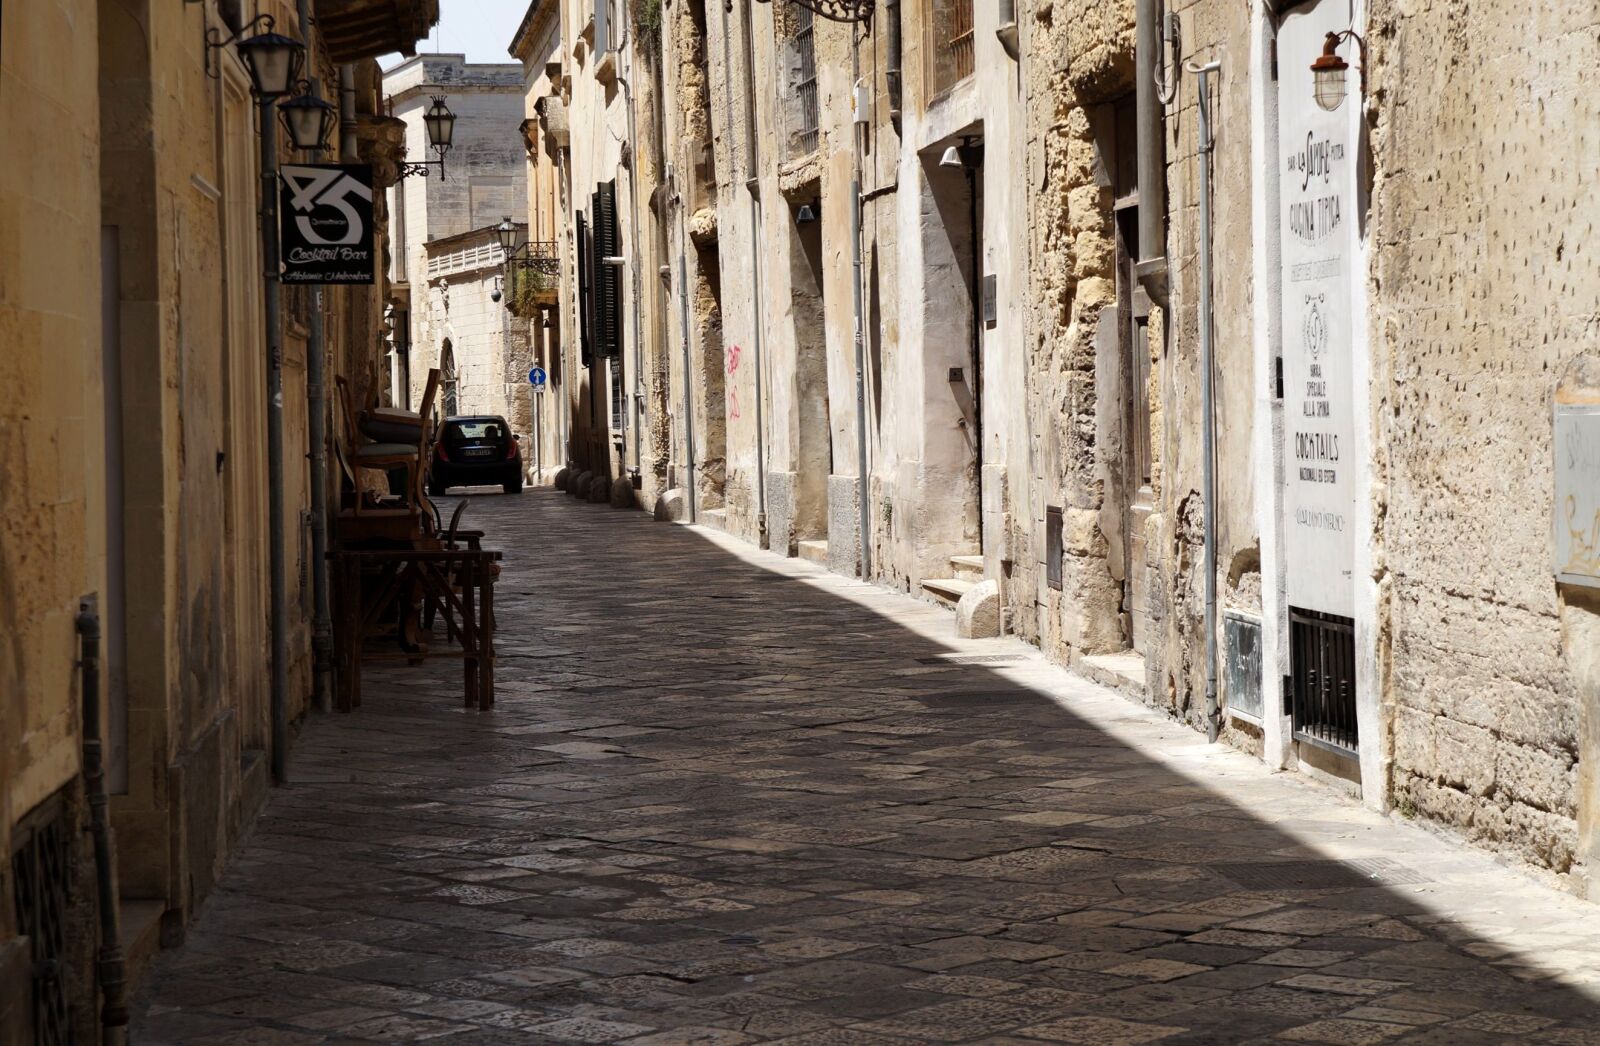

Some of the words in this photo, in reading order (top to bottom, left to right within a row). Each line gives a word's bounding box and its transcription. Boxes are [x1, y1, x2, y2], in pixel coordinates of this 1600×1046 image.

[1298, 152, 1306, 172] LA
[281, 166, 372, 244] 45
[1290, 200, 1314, 240] CUCINA
[1318, 194, 1340, 239] TIPICA
[287, 246, 340, 264] Cocktail
[340, 247, 368, 261] Bar
[1306, 381, 1326, 397] SPECIALE
[1304, 401, 1315, 416] ALLA
[1317, 400, 1329, 416] SPINA
[1296, 431, 1338, 461] COCKTAILS
